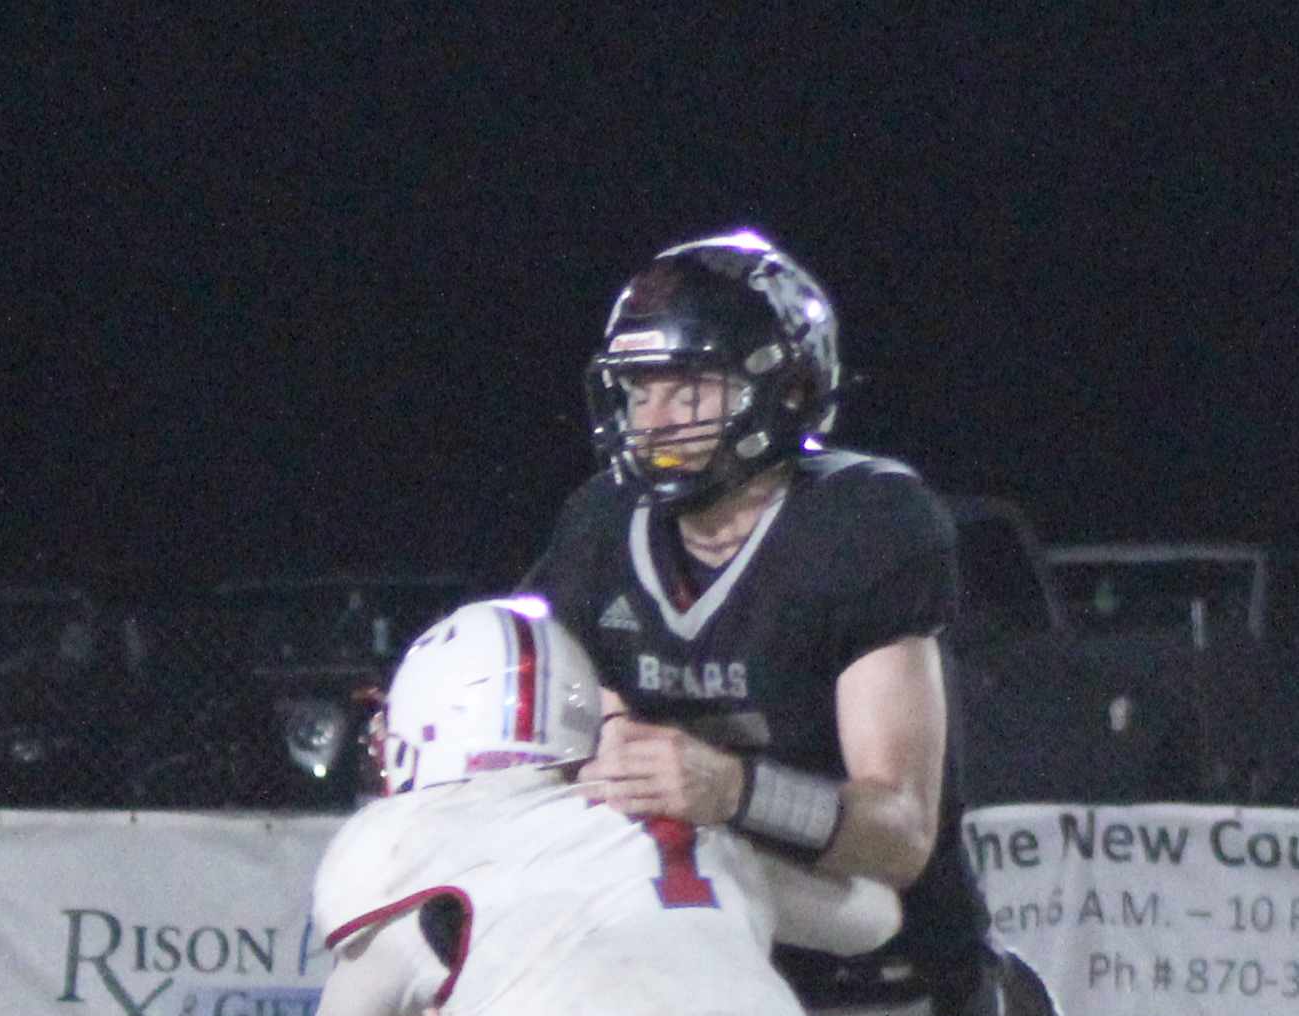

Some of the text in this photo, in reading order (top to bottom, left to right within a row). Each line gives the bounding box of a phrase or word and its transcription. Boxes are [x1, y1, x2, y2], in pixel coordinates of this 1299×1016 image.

[638, 654, 748, 698] BEARS
[969, 822, 1041, 873] he
[1059, 809, 1189, 866] New
[994, 901, 1041, 934] en
[1078, 888, 1171, 928] A.M.
[1228, 896, 1275, 933] 10
[1089, 952, 1134, 991] Ph
